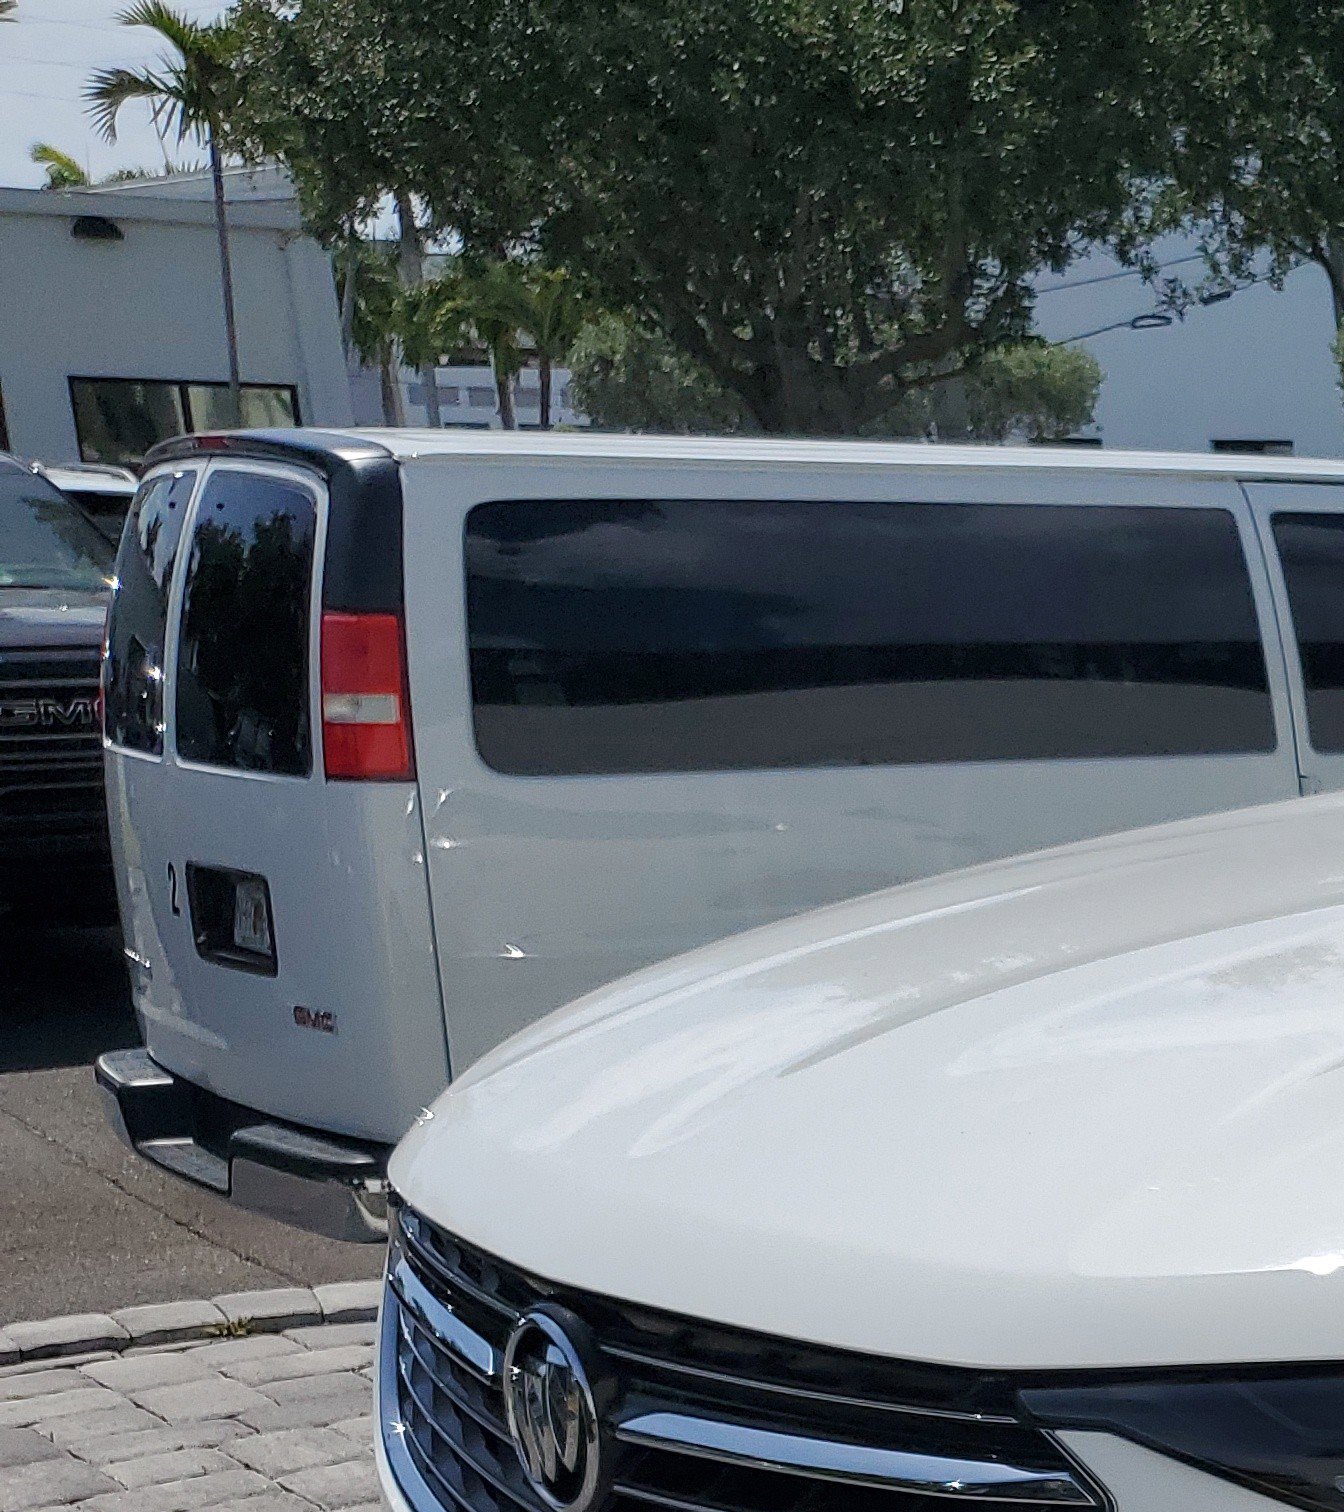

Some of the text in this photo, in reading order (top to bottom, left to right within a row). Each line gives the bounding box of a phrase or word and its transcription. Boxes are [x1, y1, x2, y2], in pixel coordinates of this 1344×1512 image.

[0, 699, 104, 726] GM
[168, 861, 180, 917] 2
[293, 1005, 336, 1033] GMC
